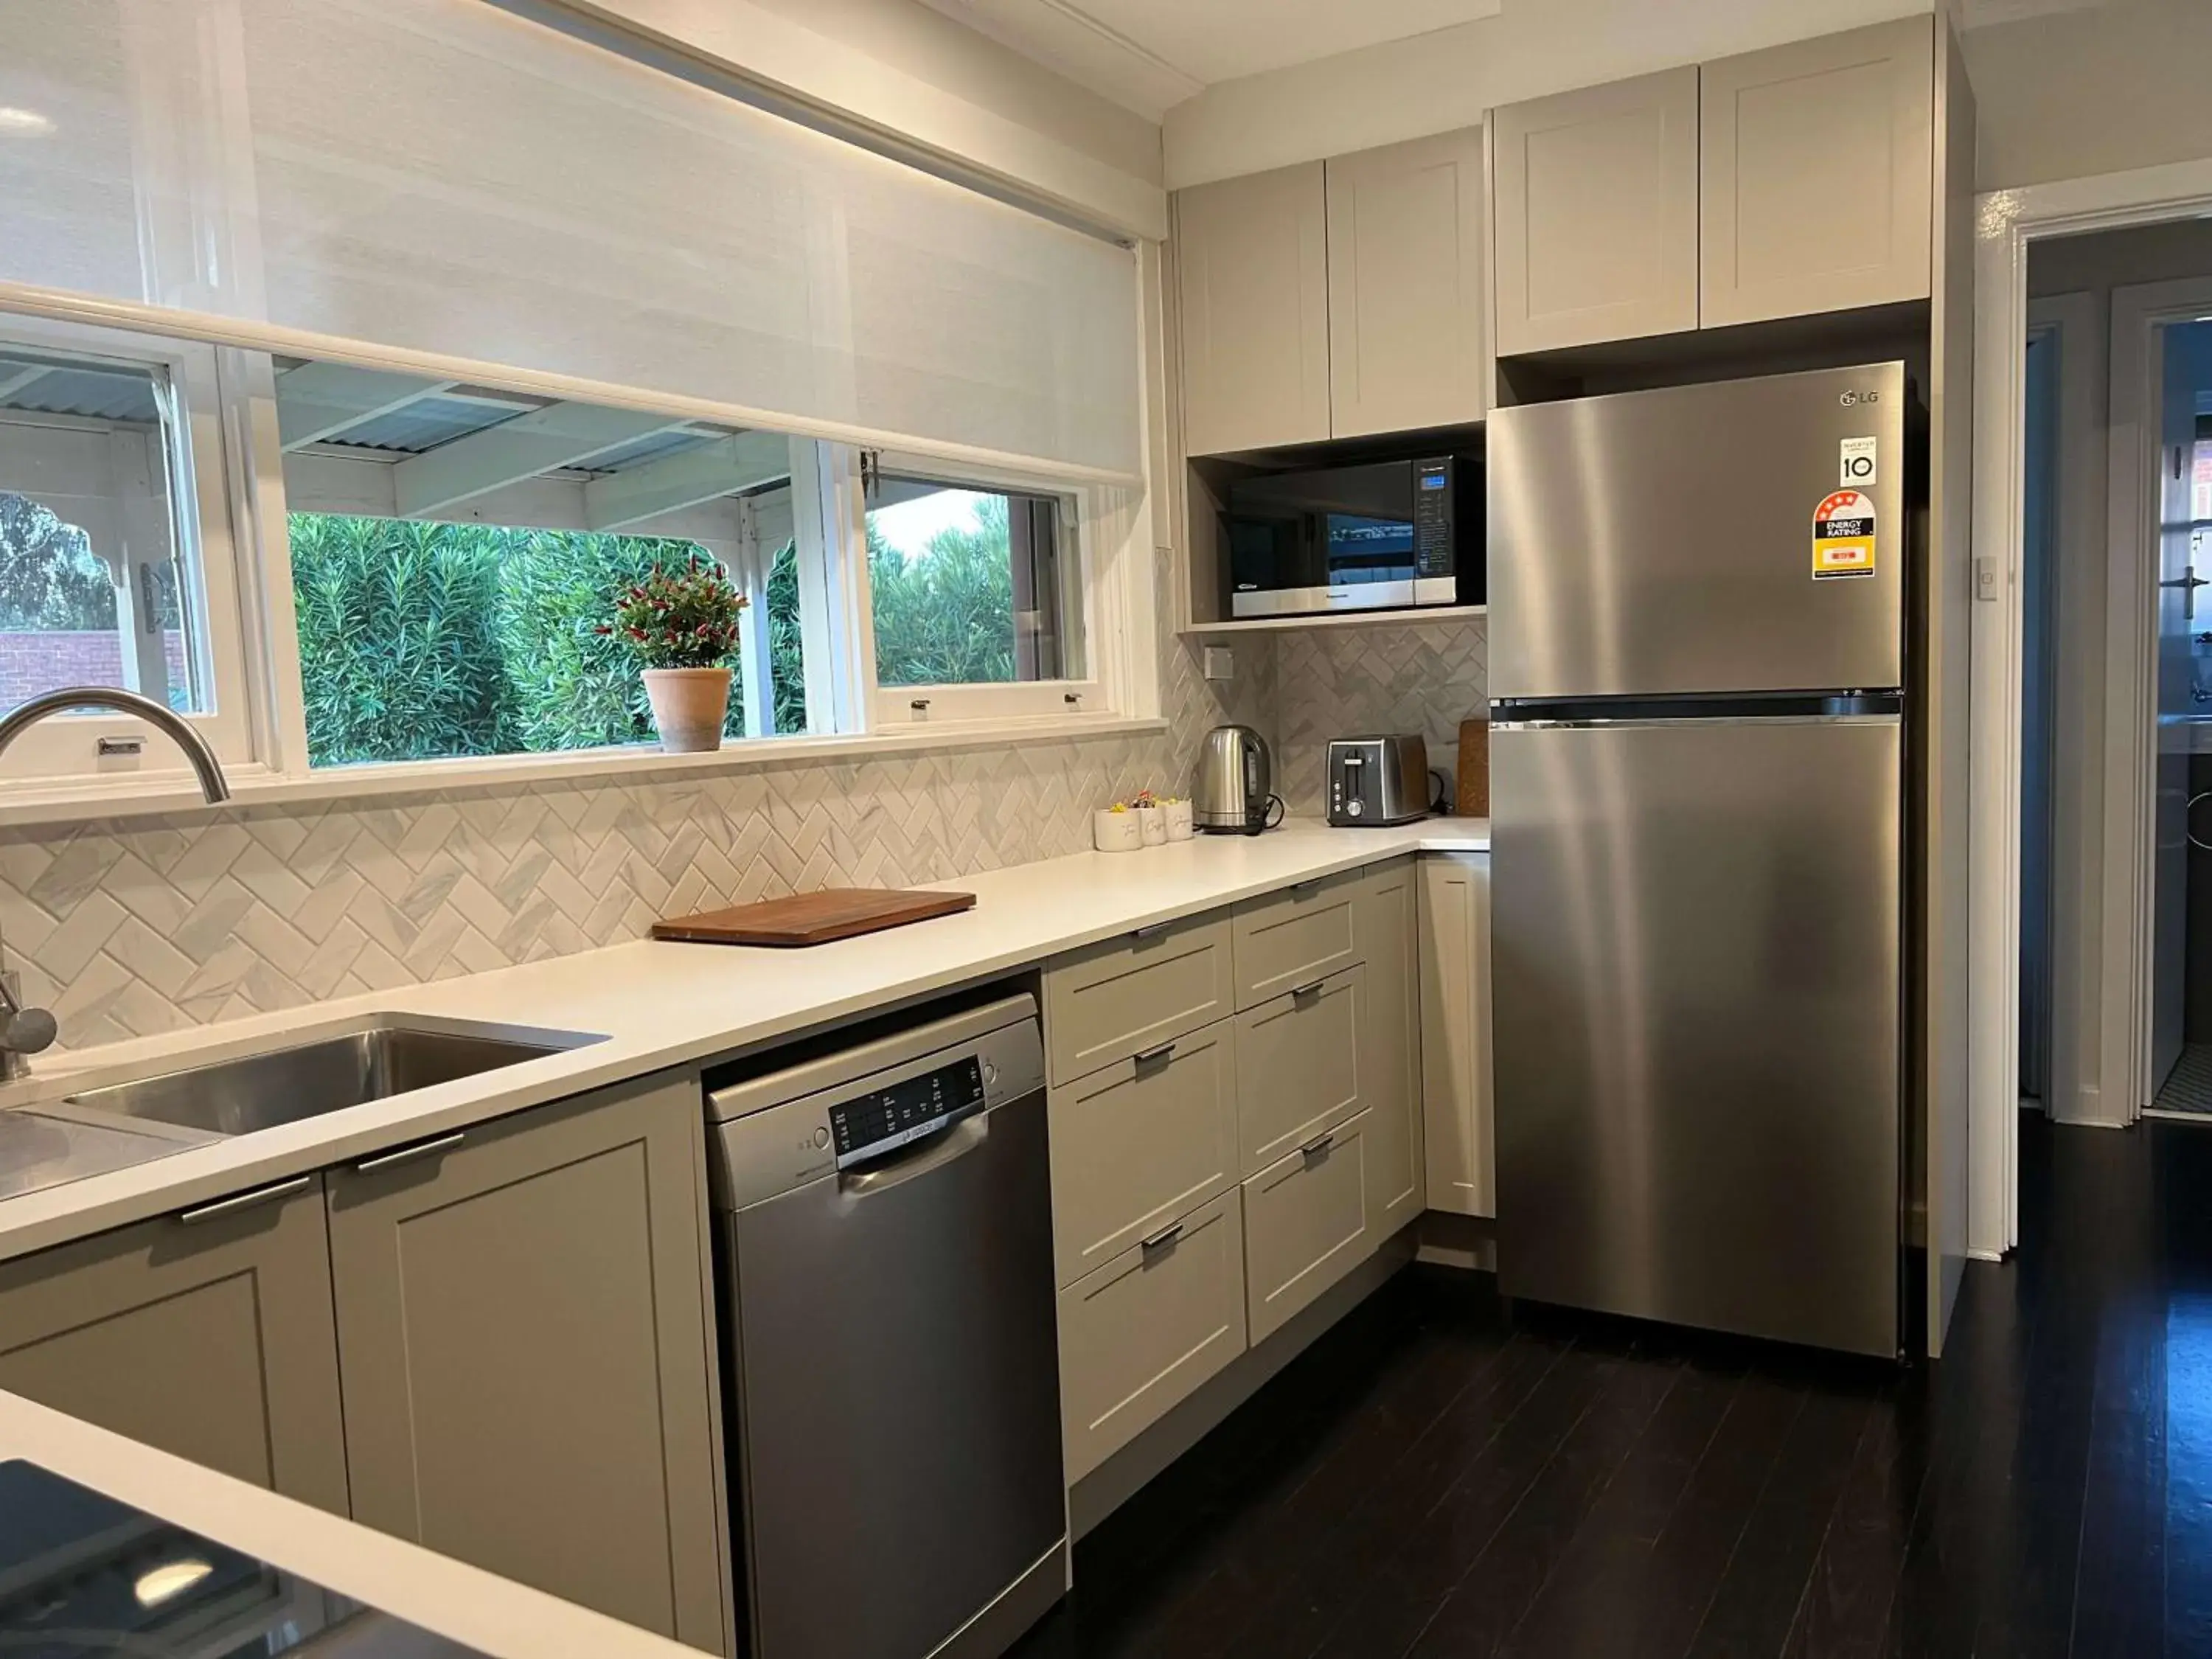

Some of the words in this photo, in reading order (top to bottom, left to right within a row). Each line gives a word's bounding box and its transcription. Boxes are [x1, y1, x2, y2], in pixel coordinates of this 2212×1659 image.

[1860, 391, 1878, 403] LG
[1844, 456, 1873, 478] 10
[1826, 520, 1863, 529] ENERGY
[1827, 528, 1861, 537] RATING
